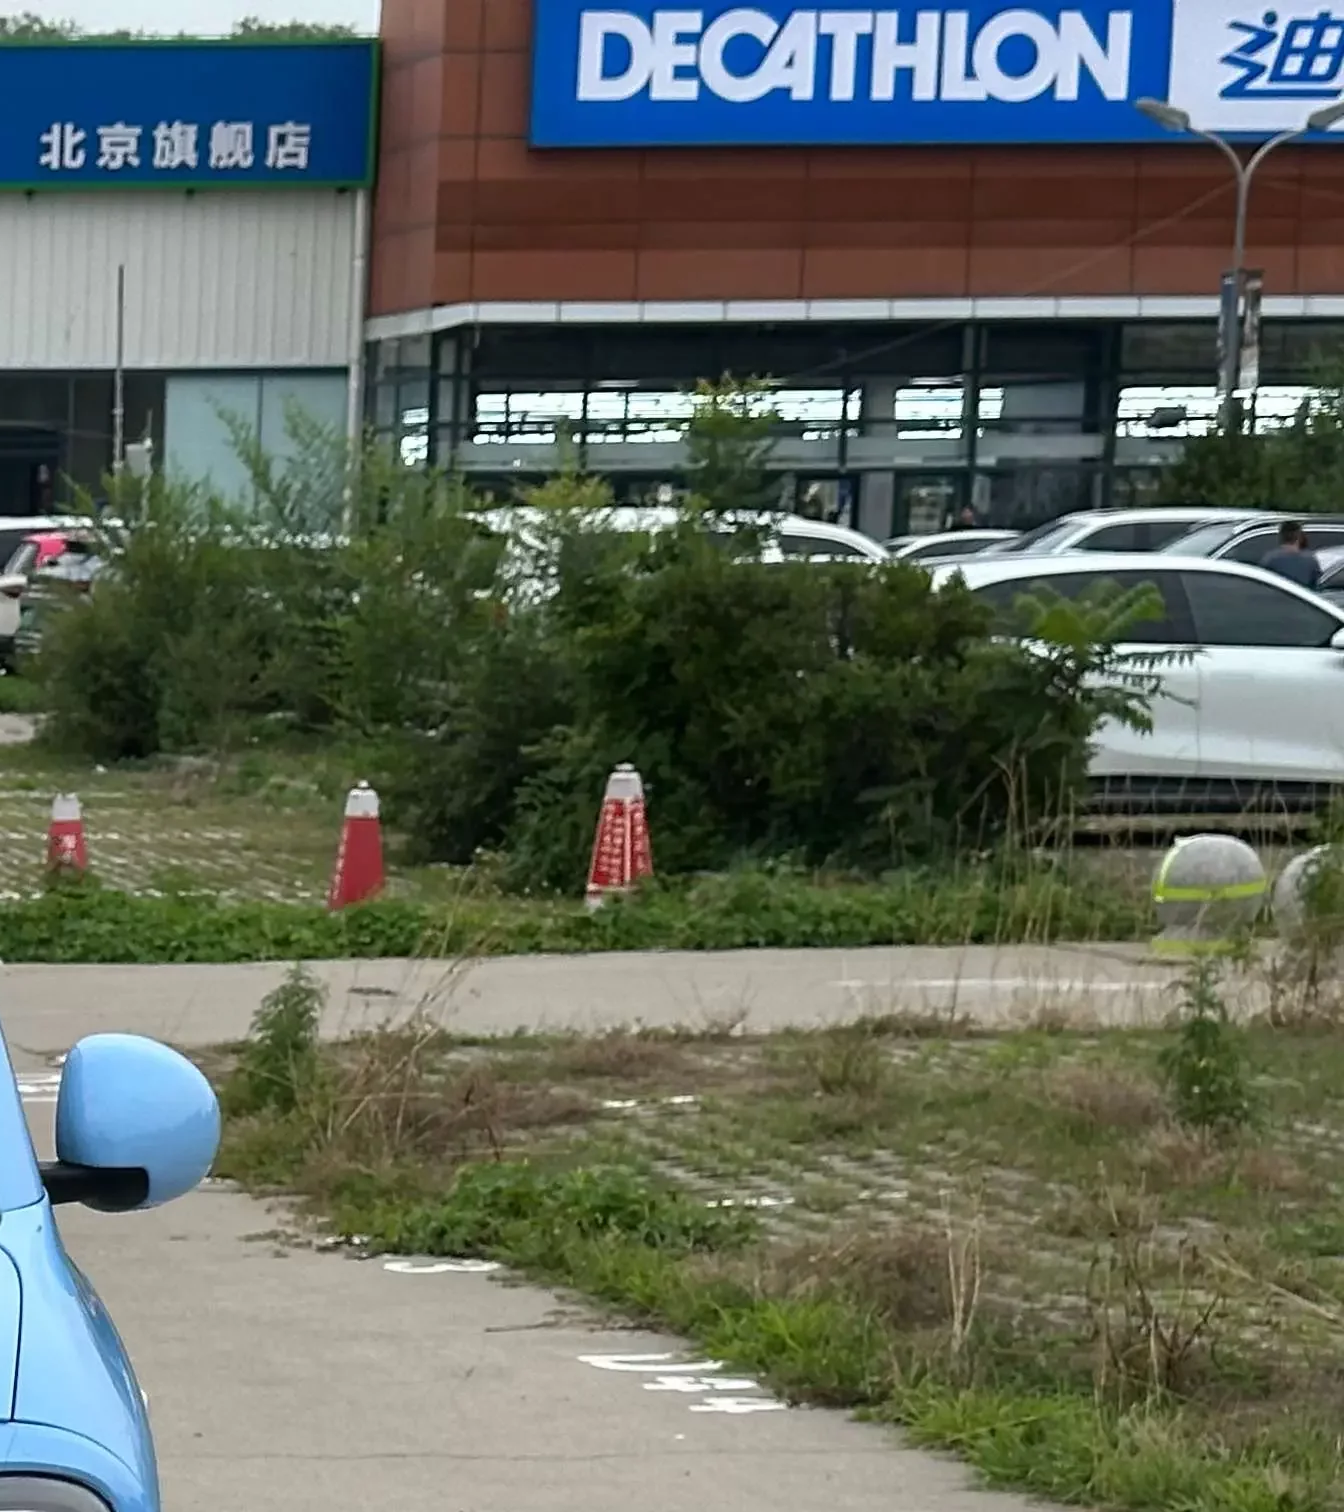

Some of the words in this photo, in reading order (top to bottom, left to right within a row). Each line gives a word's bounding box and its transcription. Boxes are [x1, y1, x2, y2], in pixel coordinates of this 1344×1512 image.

[576, 9, 1132, 103] DECATHLON
[39, 121, 311, 170] 北京旗舰店
